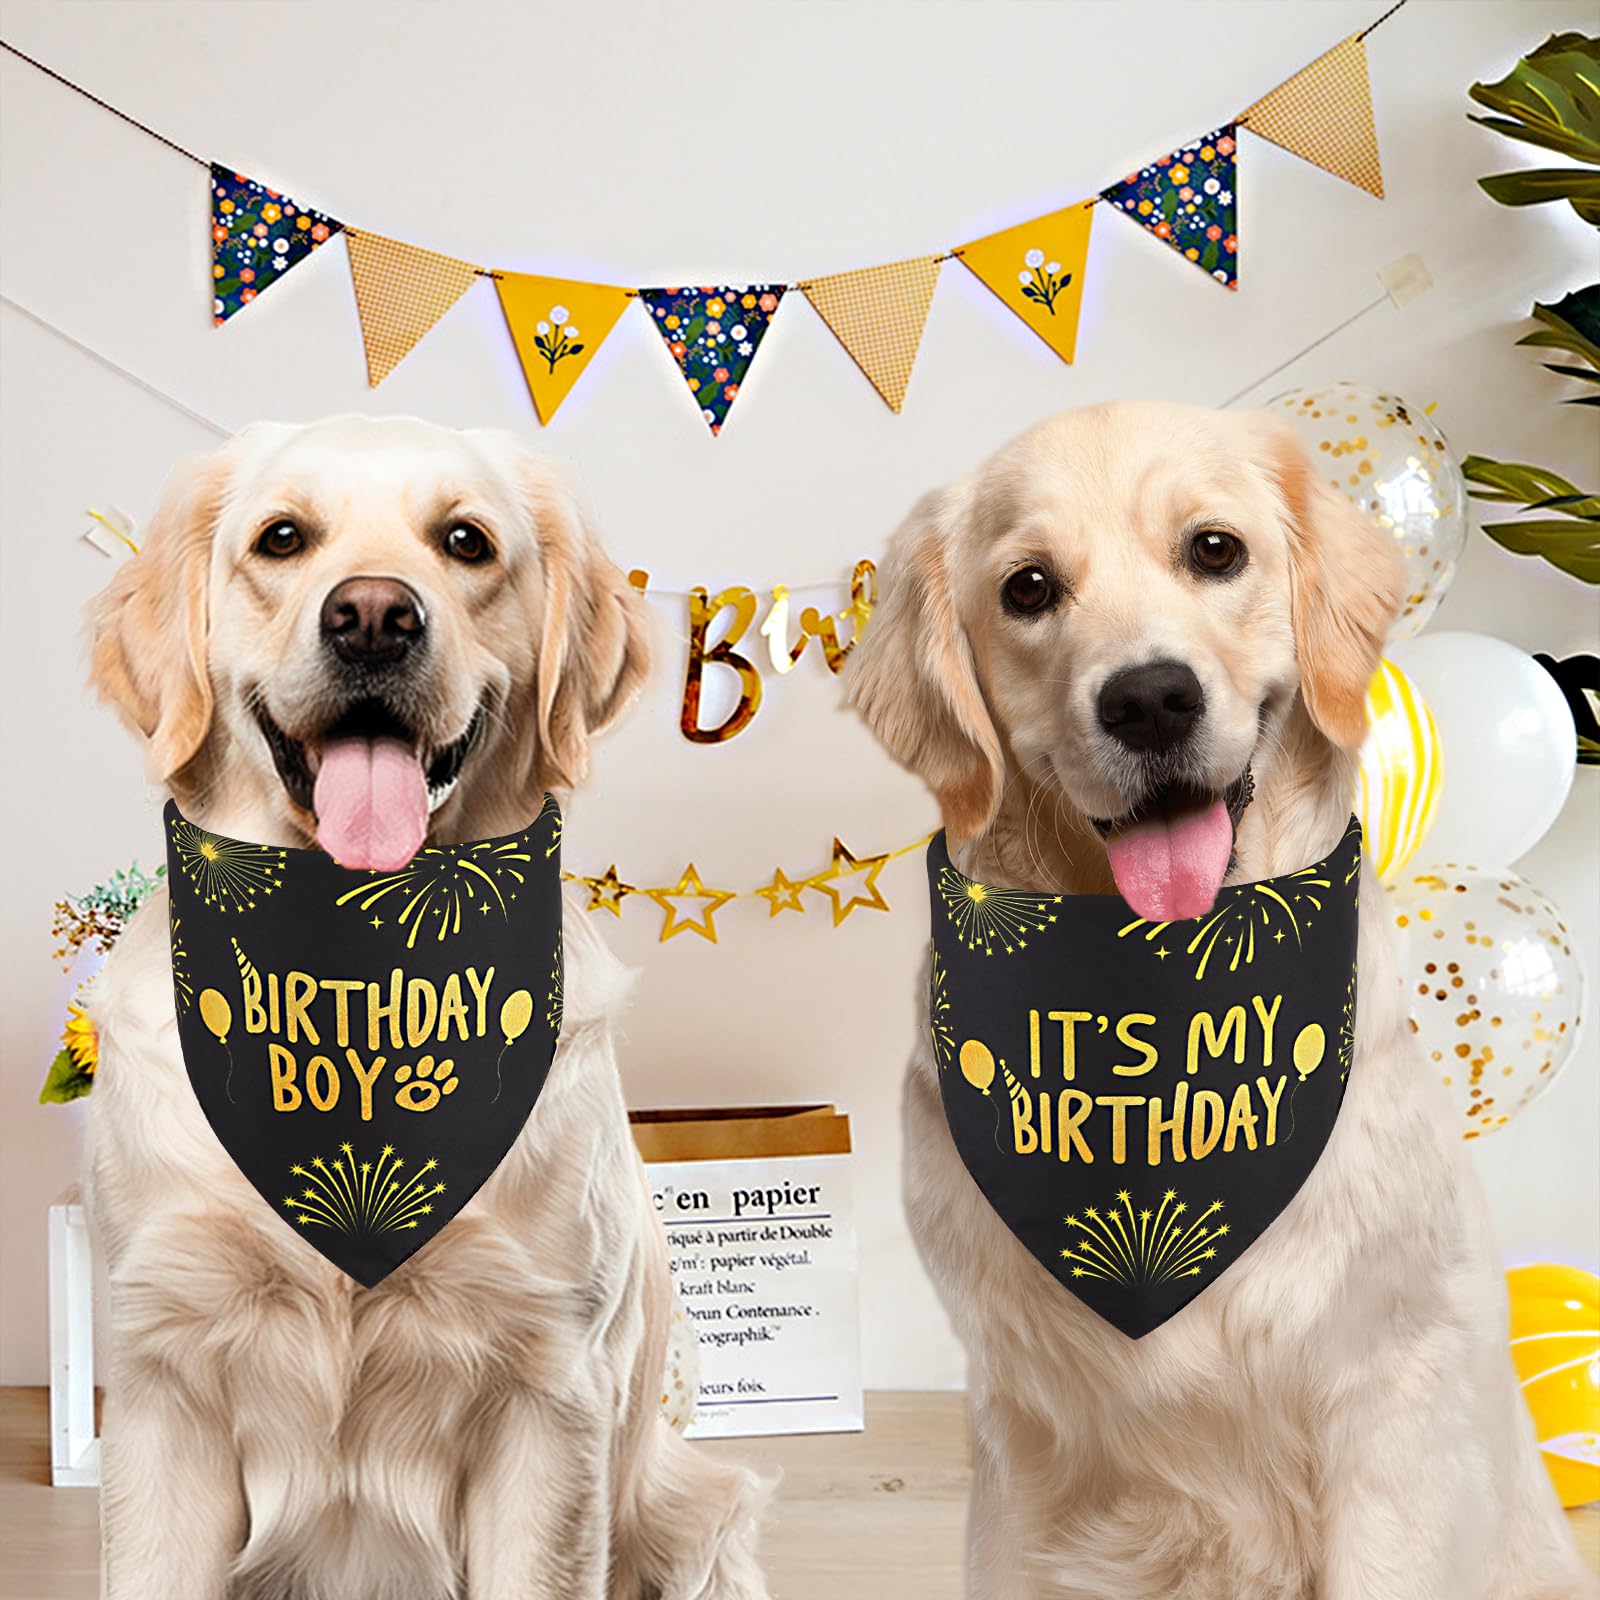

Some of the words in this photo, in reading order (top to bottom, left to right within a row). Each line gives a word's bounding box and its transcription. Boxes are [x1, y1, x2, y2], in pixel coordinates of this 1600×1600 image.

[243, 966, 495, 1051] BIRTHDAY
[1029, 1008, 1159, 1081] IT'S
[1186, 994, 1283, 1075] MY
[268, 1042, 387, 1121] BOY
[1011, 1074, 1287, 1166] BIRTHDAY
[676, 1189, 710, 1210] en
[732, 1181, 821, 1216] papier
[711, 1254, 755, 1271] papier
[718, 1228, 757, 1247] partir
[760, 1226, 778, 1241] de
[780, 1224, 832, 1240] Double
[680, 1281, 713, 1296] kraft
[717, 1280, 755, 1294] blanc
